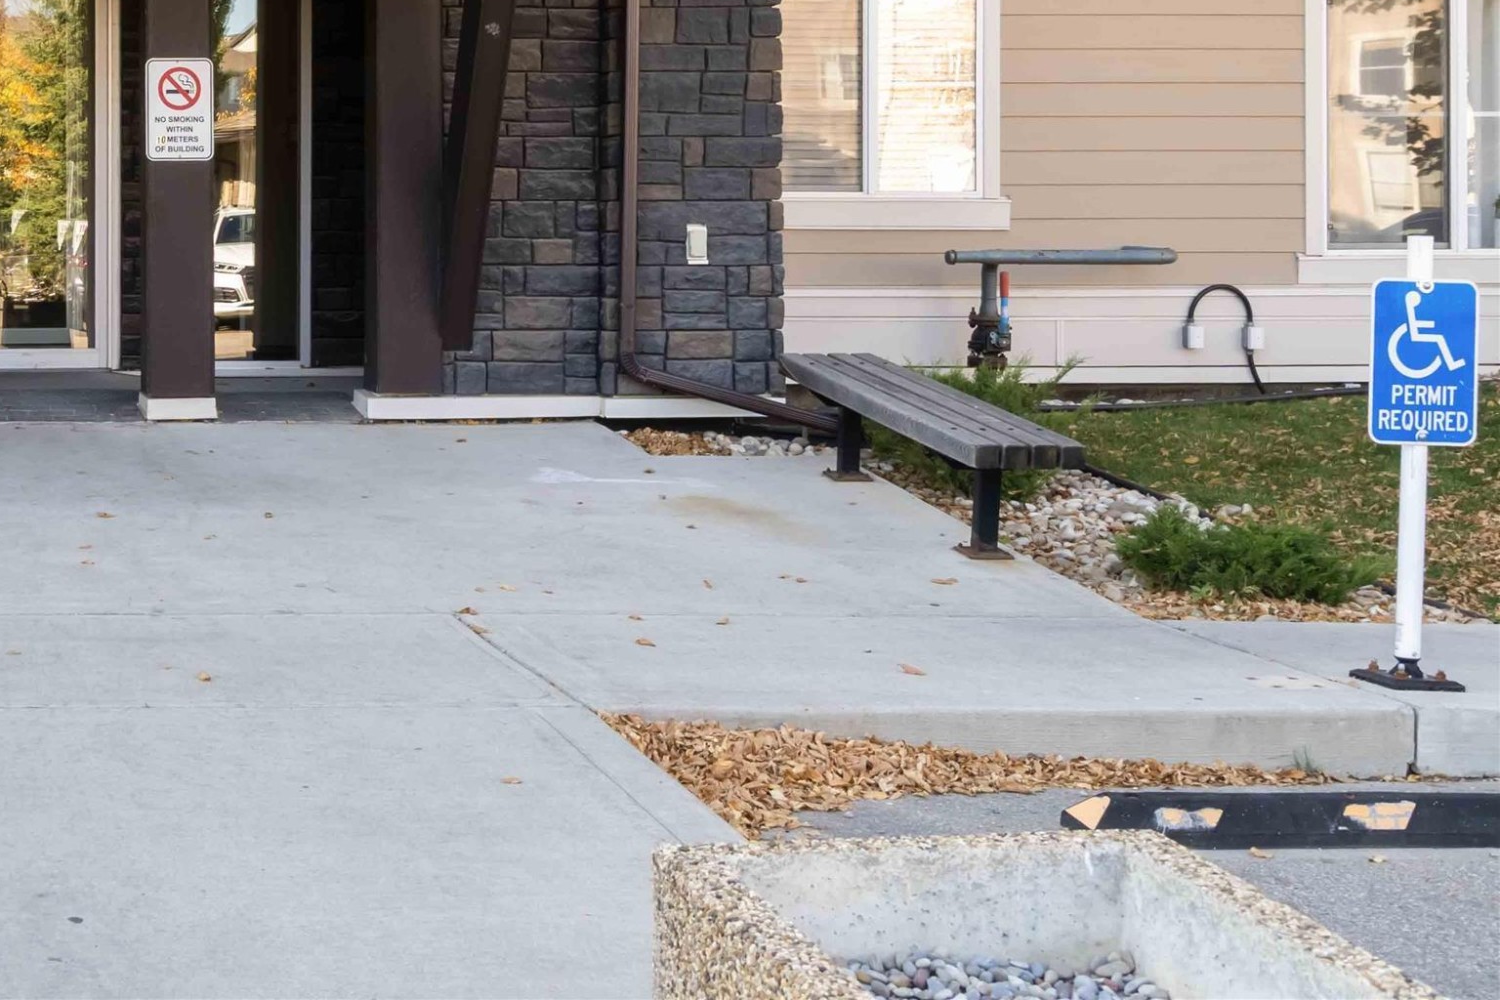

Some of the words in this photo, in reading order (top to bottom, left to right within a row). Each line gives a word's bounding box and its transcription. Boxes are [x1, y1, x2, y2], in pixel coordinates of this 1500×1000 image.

[157, 135, 166, 144] 10
[1391, 384, 1457, 406] PERMIT
[1378, 409, 1468, 432] REQUIRED
